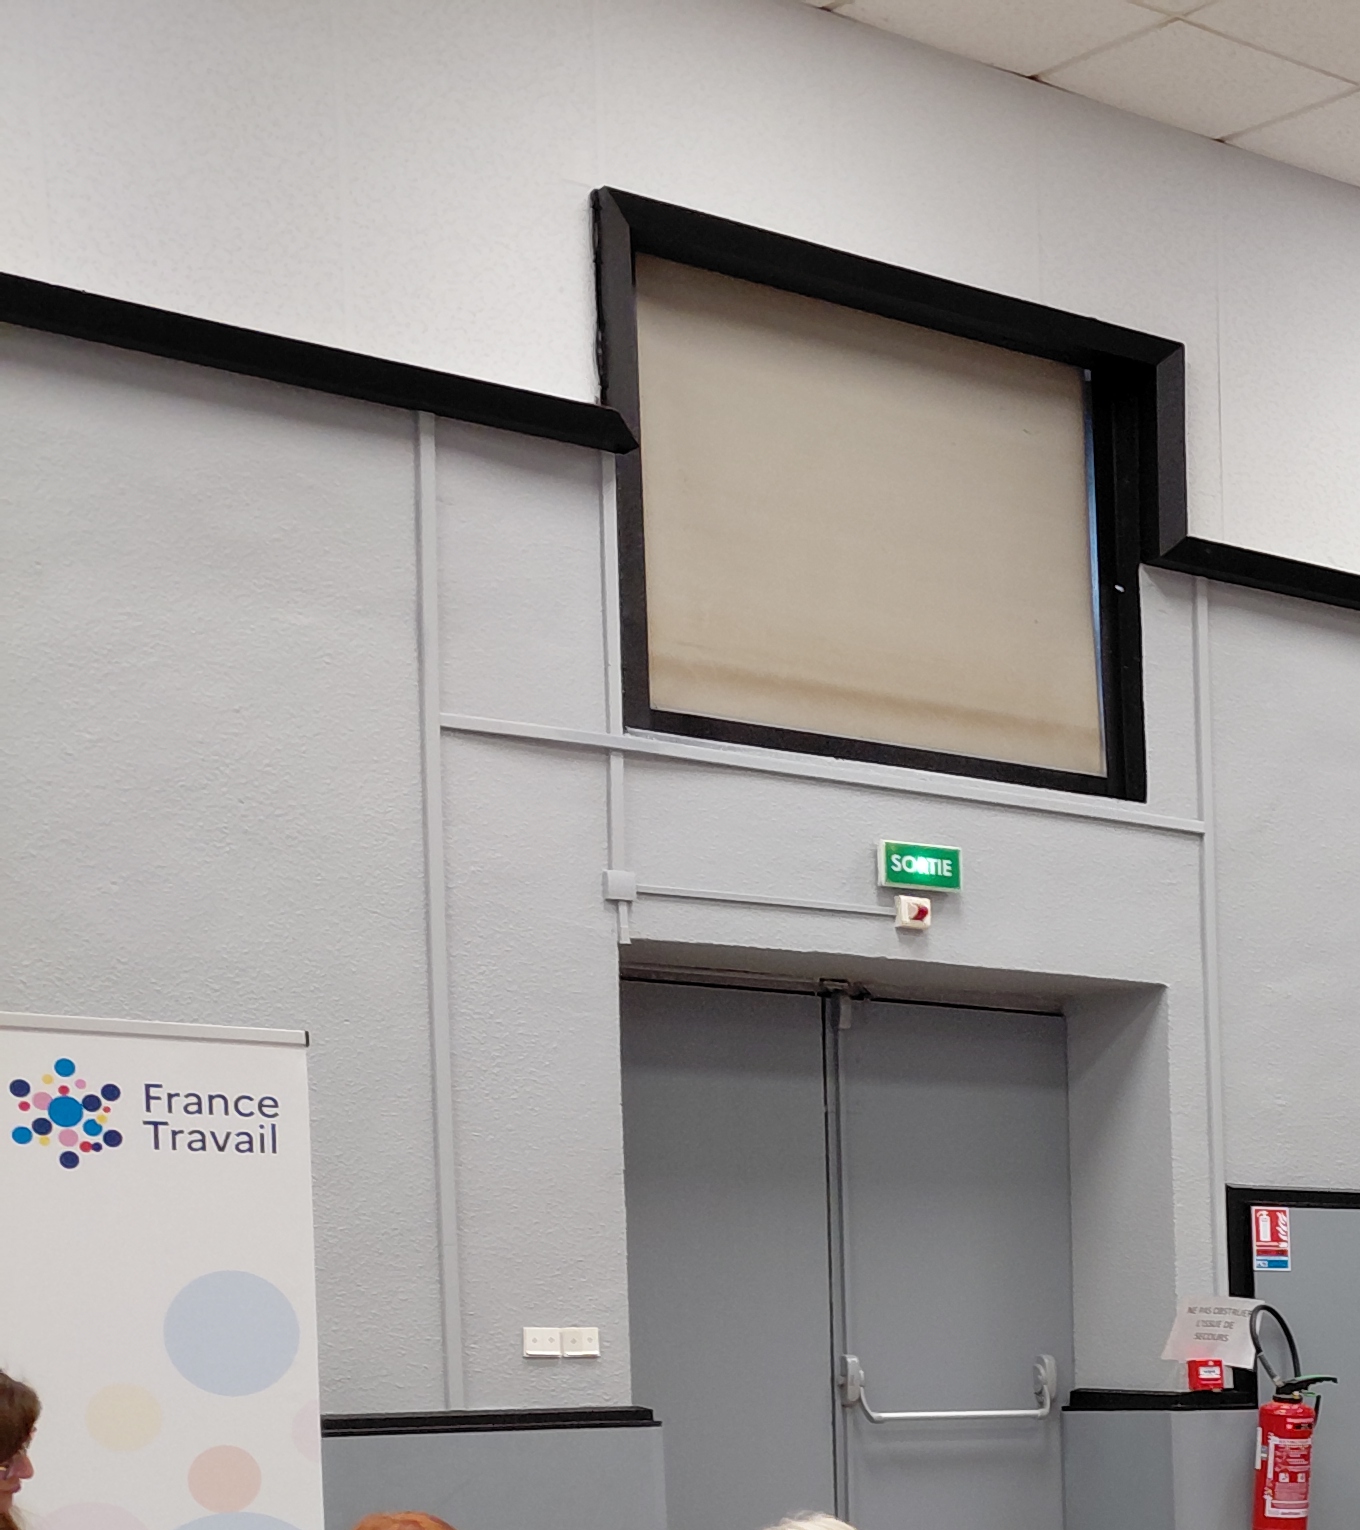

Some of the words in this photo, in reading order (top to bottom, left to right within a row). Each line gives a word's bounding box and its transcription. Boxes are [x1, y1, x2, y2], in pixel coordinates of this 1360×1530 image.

[890, 853, 953, 877] SORTIE
[142, 1082, 281, 1119] France
[141, 1119, 279, 1155] Travail
